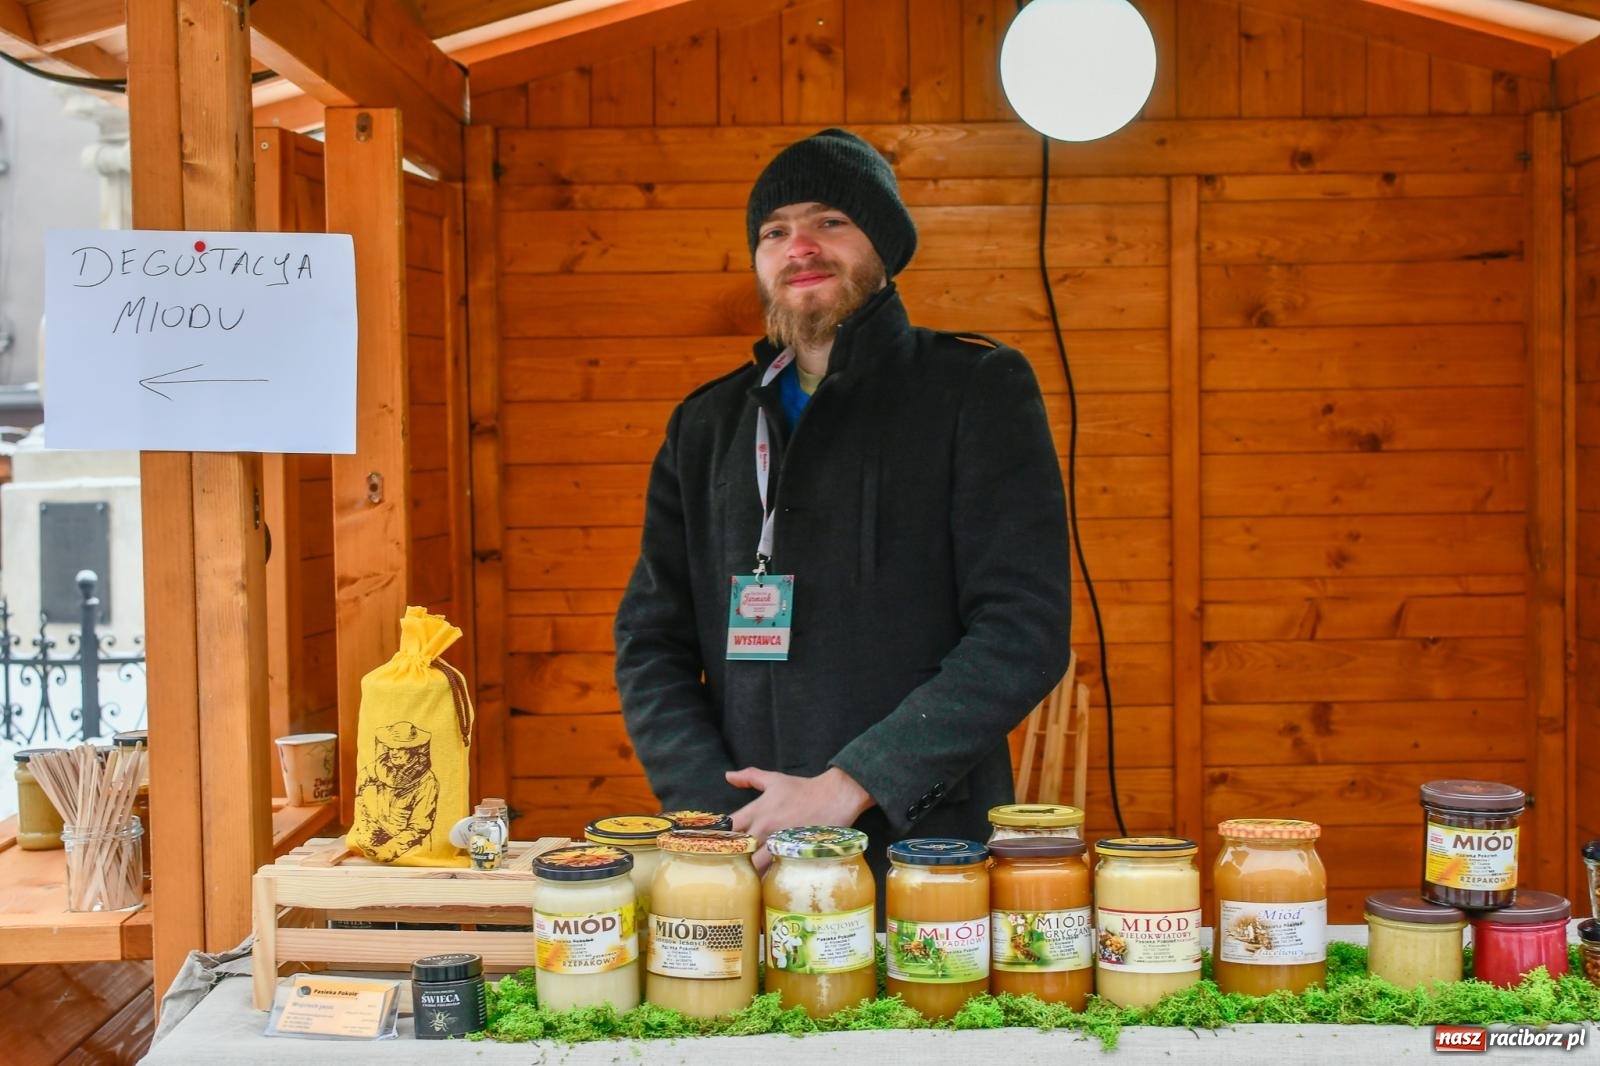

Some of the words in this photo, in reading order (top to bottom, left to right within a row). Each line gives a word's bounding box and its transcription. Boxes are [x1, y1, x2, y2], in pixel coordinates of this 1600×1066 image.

[112, 296, 244, 333] MIODU
[734, 635, 782, 646] WYSTAWCA
[1453, 832, 1513, 851] MIÓD
[553, 915, 616, 935] MIÓD
[656, 919, 708, 941] MIÓD
[1037, 913, 1085, 930] MIÓD
[1121, 916, 1189, 932] MIÓD
[919, 923, 985, 941] MIÓD
[1119, 932, 1192, 940] WIELOKWIATOWY
[562, 957, 616, 967] RZEPAKOWY
[421, 993, 460, 1004] ŚWIECA
